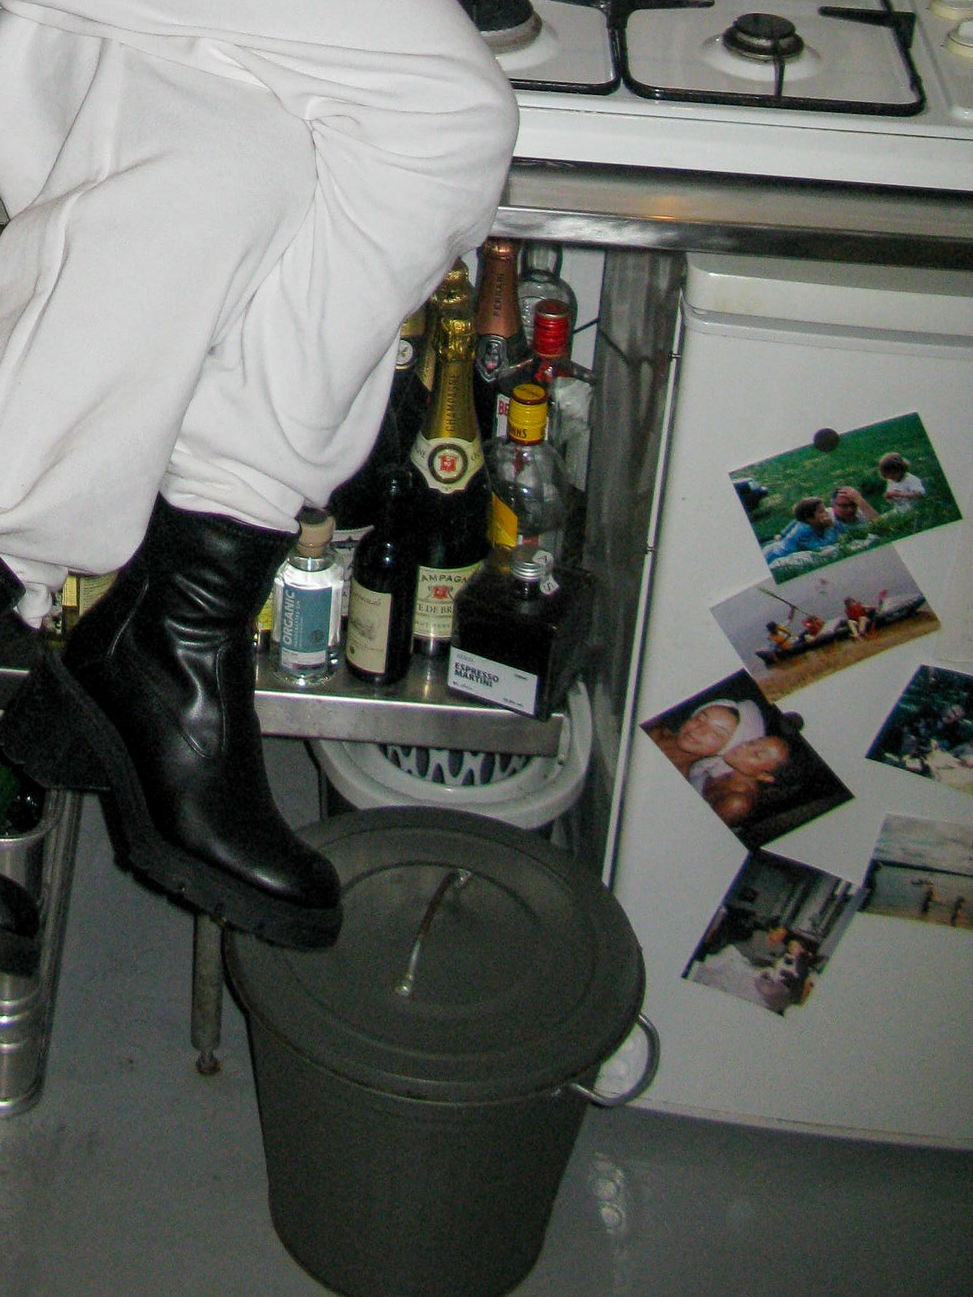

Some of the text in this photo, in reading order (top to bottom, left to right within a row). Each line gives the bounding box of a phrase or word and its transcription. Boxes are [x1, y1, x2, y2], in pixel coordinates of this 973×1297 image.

[445, 373, 458, 432] CHAMPAGNE
[283, 589, 295, 645] ORGANIC
[454, 662, 500, 683] ESPRESSO
[454, 669, 493, 688] MARTINI
